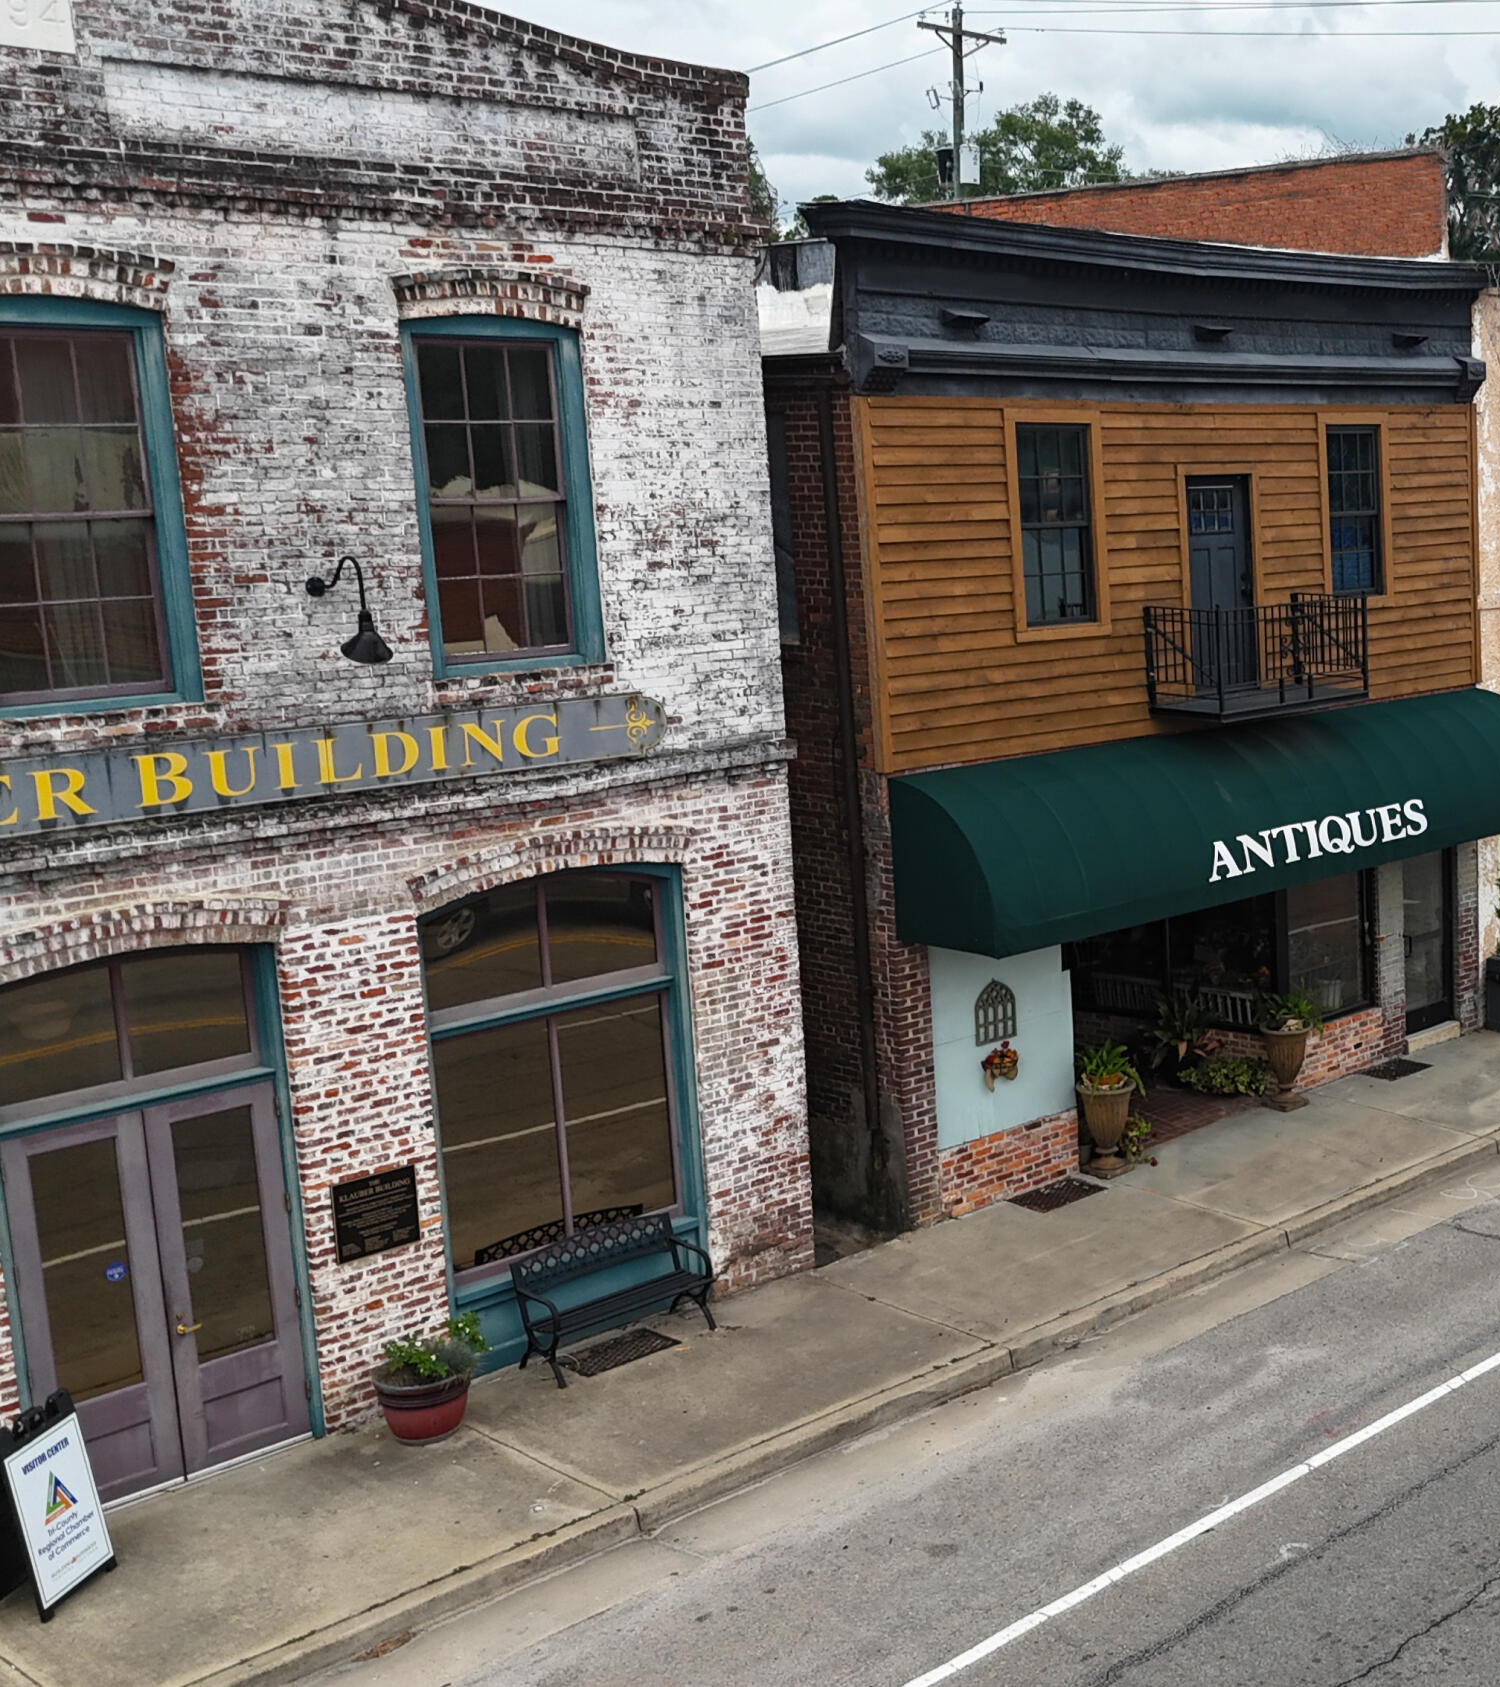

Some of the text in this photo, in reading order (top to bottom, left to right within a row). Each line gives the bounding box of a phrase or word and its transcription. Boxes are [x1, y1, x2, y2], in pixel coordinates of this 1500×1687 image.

[129, 713, 562, 808] BUILDING
[1209, 799, 1428, 883] ANTIQUES
[21, 1437, 70, 1475] VISITOR CENTER
[38, 1511, 94, 1556] Regional Chamber
[47, 1511, 78, 1537] Tri-County
[48, 1549, 55, 1561] of
[55, 1526, 90, 1557] Commerce
